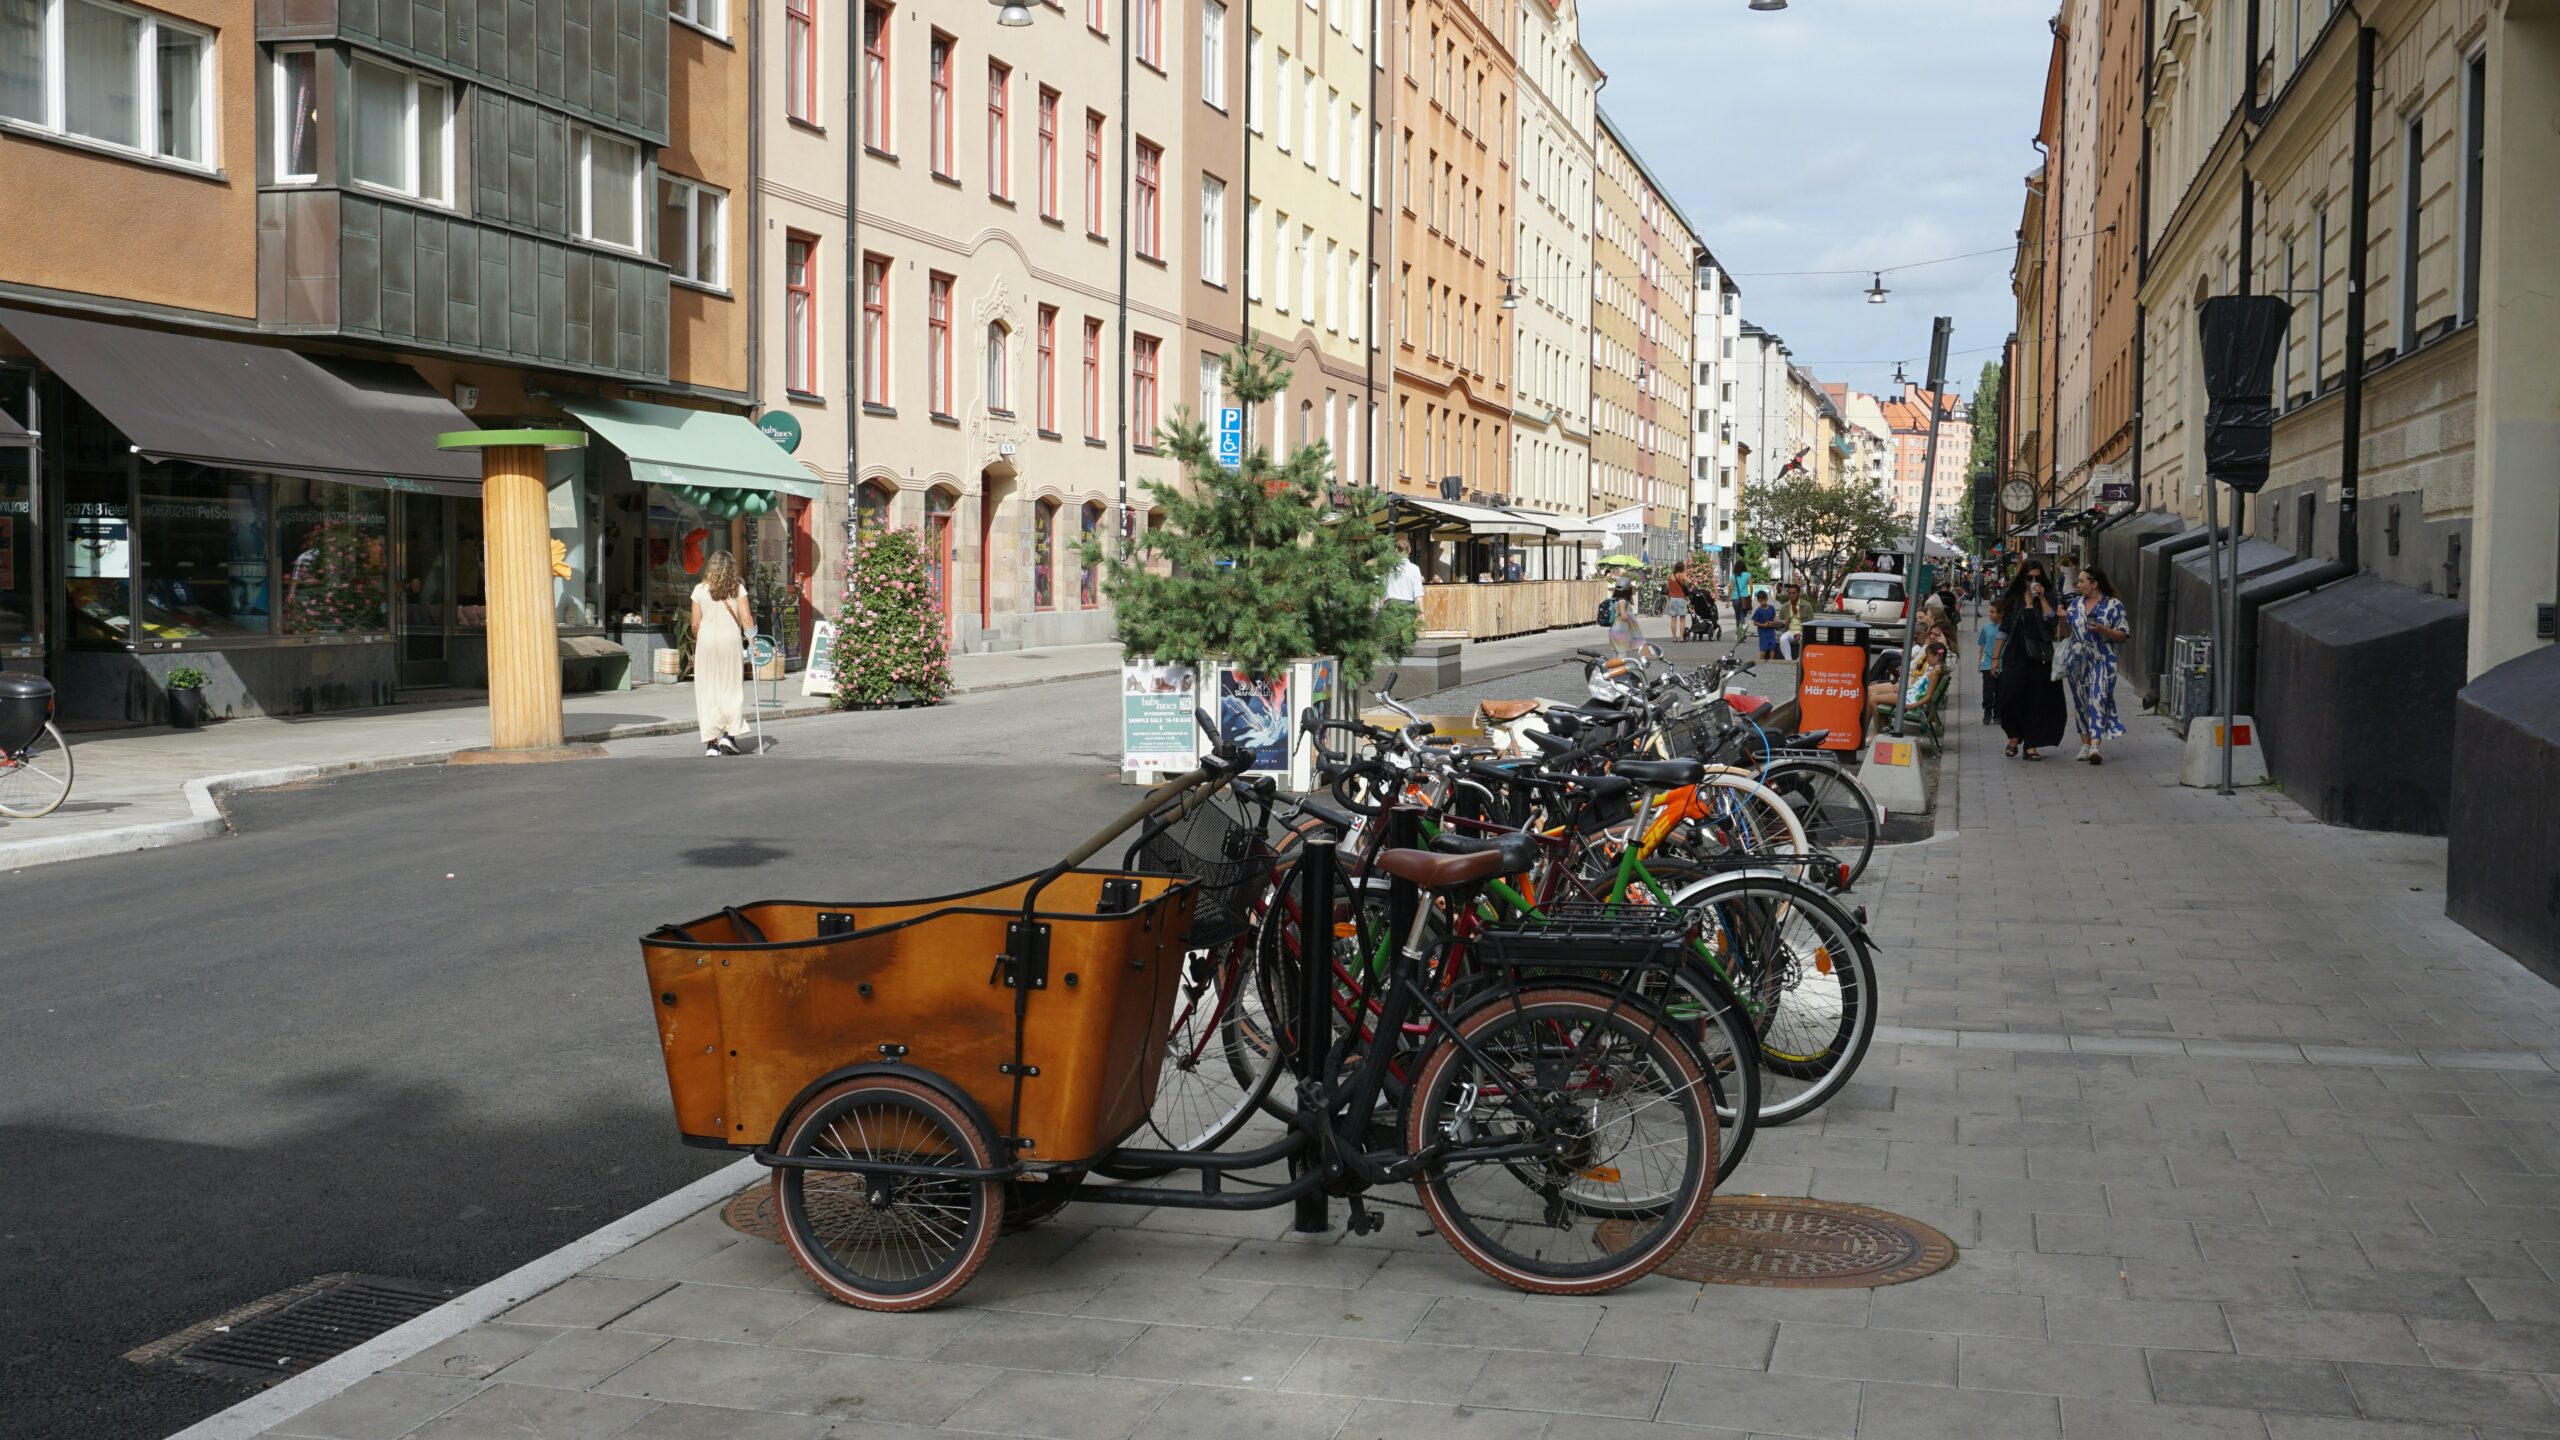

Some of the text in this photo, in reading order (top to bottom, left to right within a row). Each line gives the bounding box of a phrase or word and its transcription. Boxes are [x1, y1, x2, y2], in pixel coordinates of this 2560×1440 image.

[468, 390, 478, 399] 53
[1225, 410, 1238, 429] P
[1238, 679, 1271, 691] DARK
[1805, 685, 1860, 698] Här är jag!
